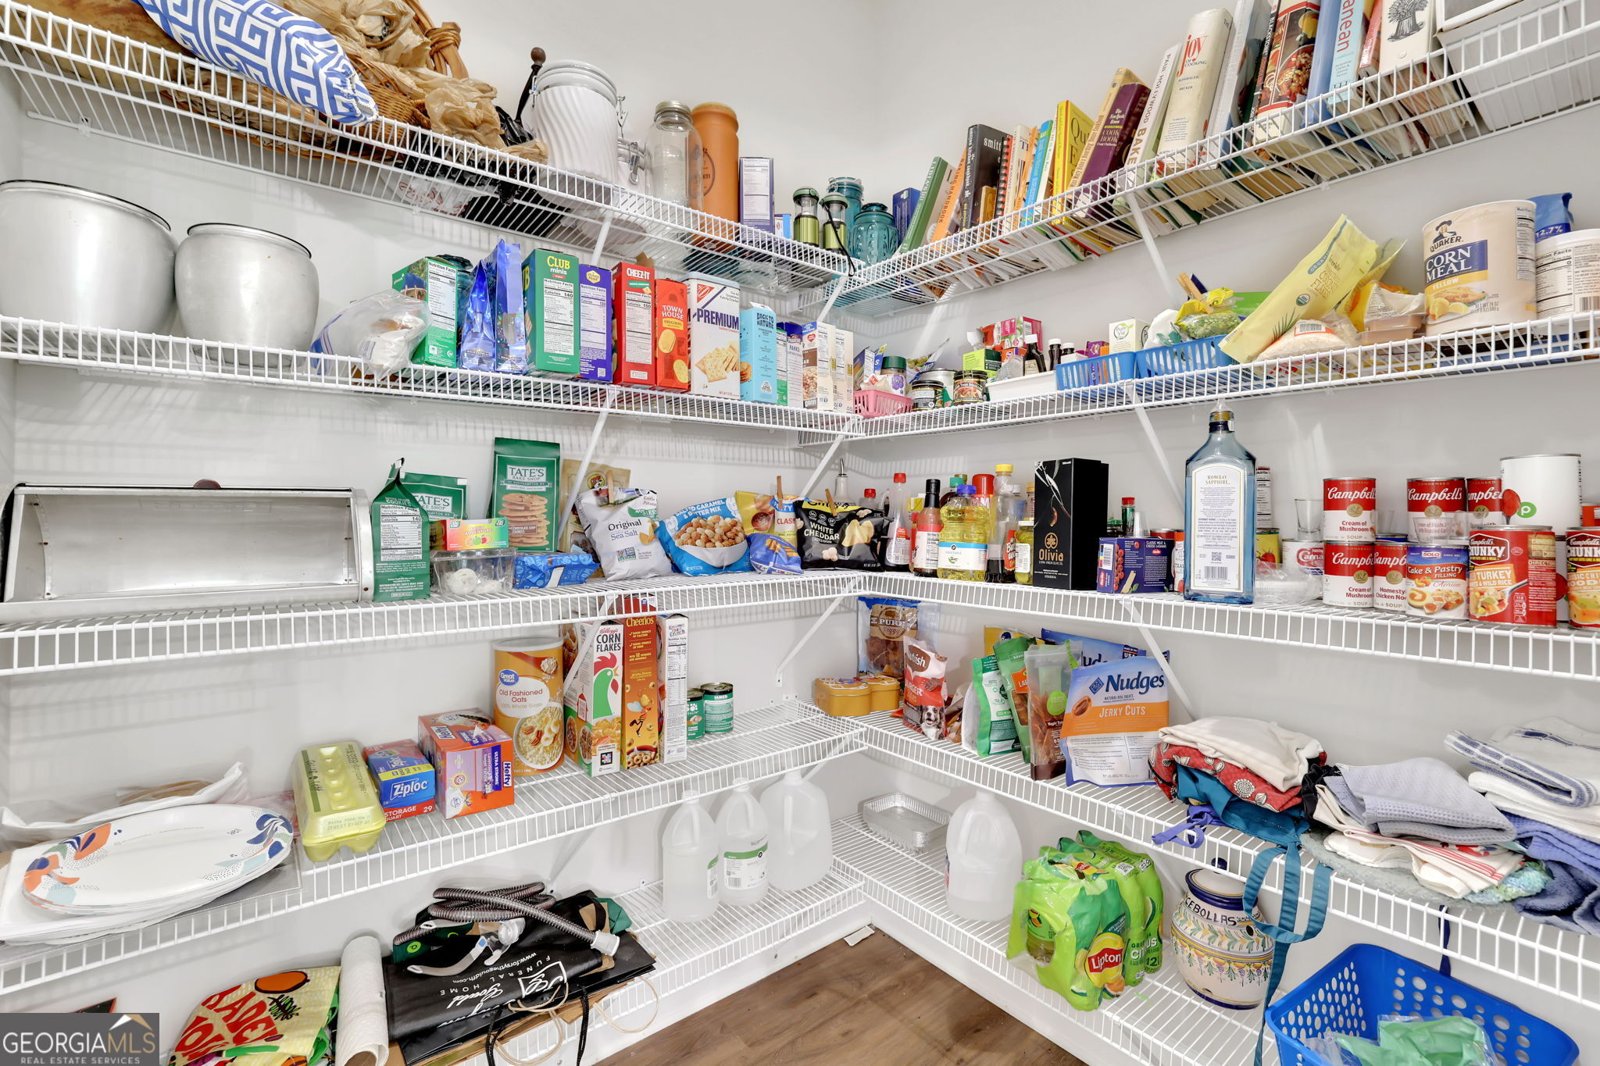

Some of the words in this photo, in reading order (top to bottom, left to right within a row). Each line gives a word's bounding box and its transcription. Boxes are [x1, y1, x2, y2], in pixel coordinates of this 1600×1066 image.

[1126, 126, 1147, 166] BAKE
[1429, 235, 1462, 253] QUAKER
[546, 255, 571, 270] CLUB
[1425, 245, 1472, 272] CORN
[626, 267, 651, 280] CHEEZ-IT
[1425, 259, 1472, 284] MEAL
[1431, 276, 1459, 291] YELLOW
[661, 311, 684, 321] HOUSE
[662, 304, 684, 315] TOWN
[696, 308, 740, 331] PREMIUM
[509, 466, 545, 478] TATE'S
[696, 499, 726, 511] CARAMEL
[709, 505, 722, 514] MIX
[608, 519, 643, 532] Original
[776, 517, 796, 526] CLASS
[809, 521, 835, 535] WHITE
[610, 532, 624, 541] Sea
[624, 530, 639, 539] Salt
[803, 528, 841, 541] CHEDDAR
[1038, 548, 1064, 562] Olivia
[1434, 565, 1463, 576] Pastry
[1477, 570, 1512, 580] TURKEY
[1379, 586, 1406, 595] Homesty
[625, 616, 655, 628] Cheerios
[596, 633, 622, 644] CORN
[596, 642, 622, 653] FLAKES
[1105, 671, 1165, 695] Nudges
[509, 688, 543, 697] Fashioned
[1099, 707, 1123, 718] JERKY
[1124, 704, 1146, 716] CUTS
[503, 762, 512, 787] Hefty
[393, 780, 428, 798] Ziploc
[384, 805, 417, 818] STORAGE
[423, 805, 433, 813] 29
[1184, 896, 1237, 926] CEBOLLAS
[1090, 951, 1123, 970] Lipton
[1146, 956, 1158, 967] 12
[489, 954, 551, 983] FUNERAL
[439, 983, 480, 996] HOME
